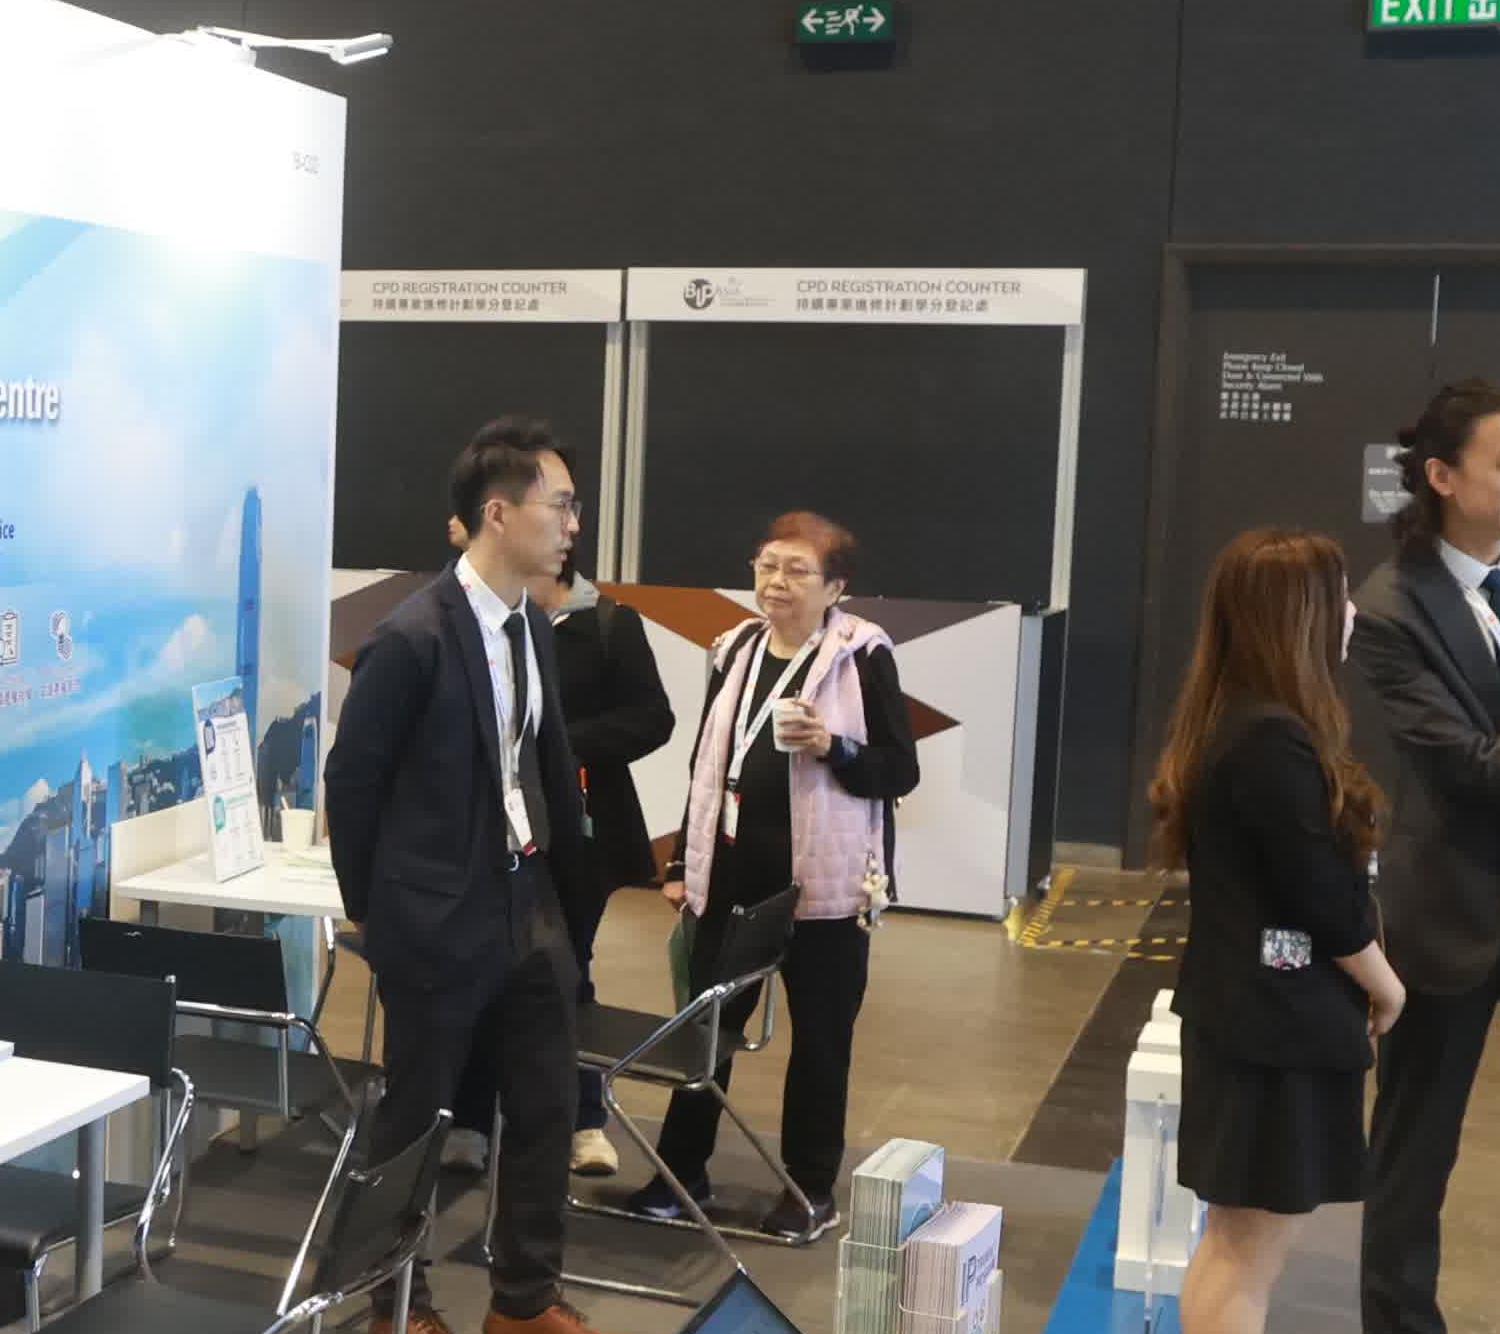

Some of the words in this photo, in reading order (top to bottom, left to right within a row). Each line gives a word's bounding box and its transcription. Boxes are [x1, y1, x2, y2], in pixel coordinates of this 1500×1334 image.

[371, 281, 400, 295] CPD
[402, 281, 499, 295] REGISTRATION
[500, 281, 568, 294] COUNTER
[796, 280, 829, 294] CPD
[830, 280, 943, 294] REGISTRATION
[944, 280, 1022, 294] COUNTER
